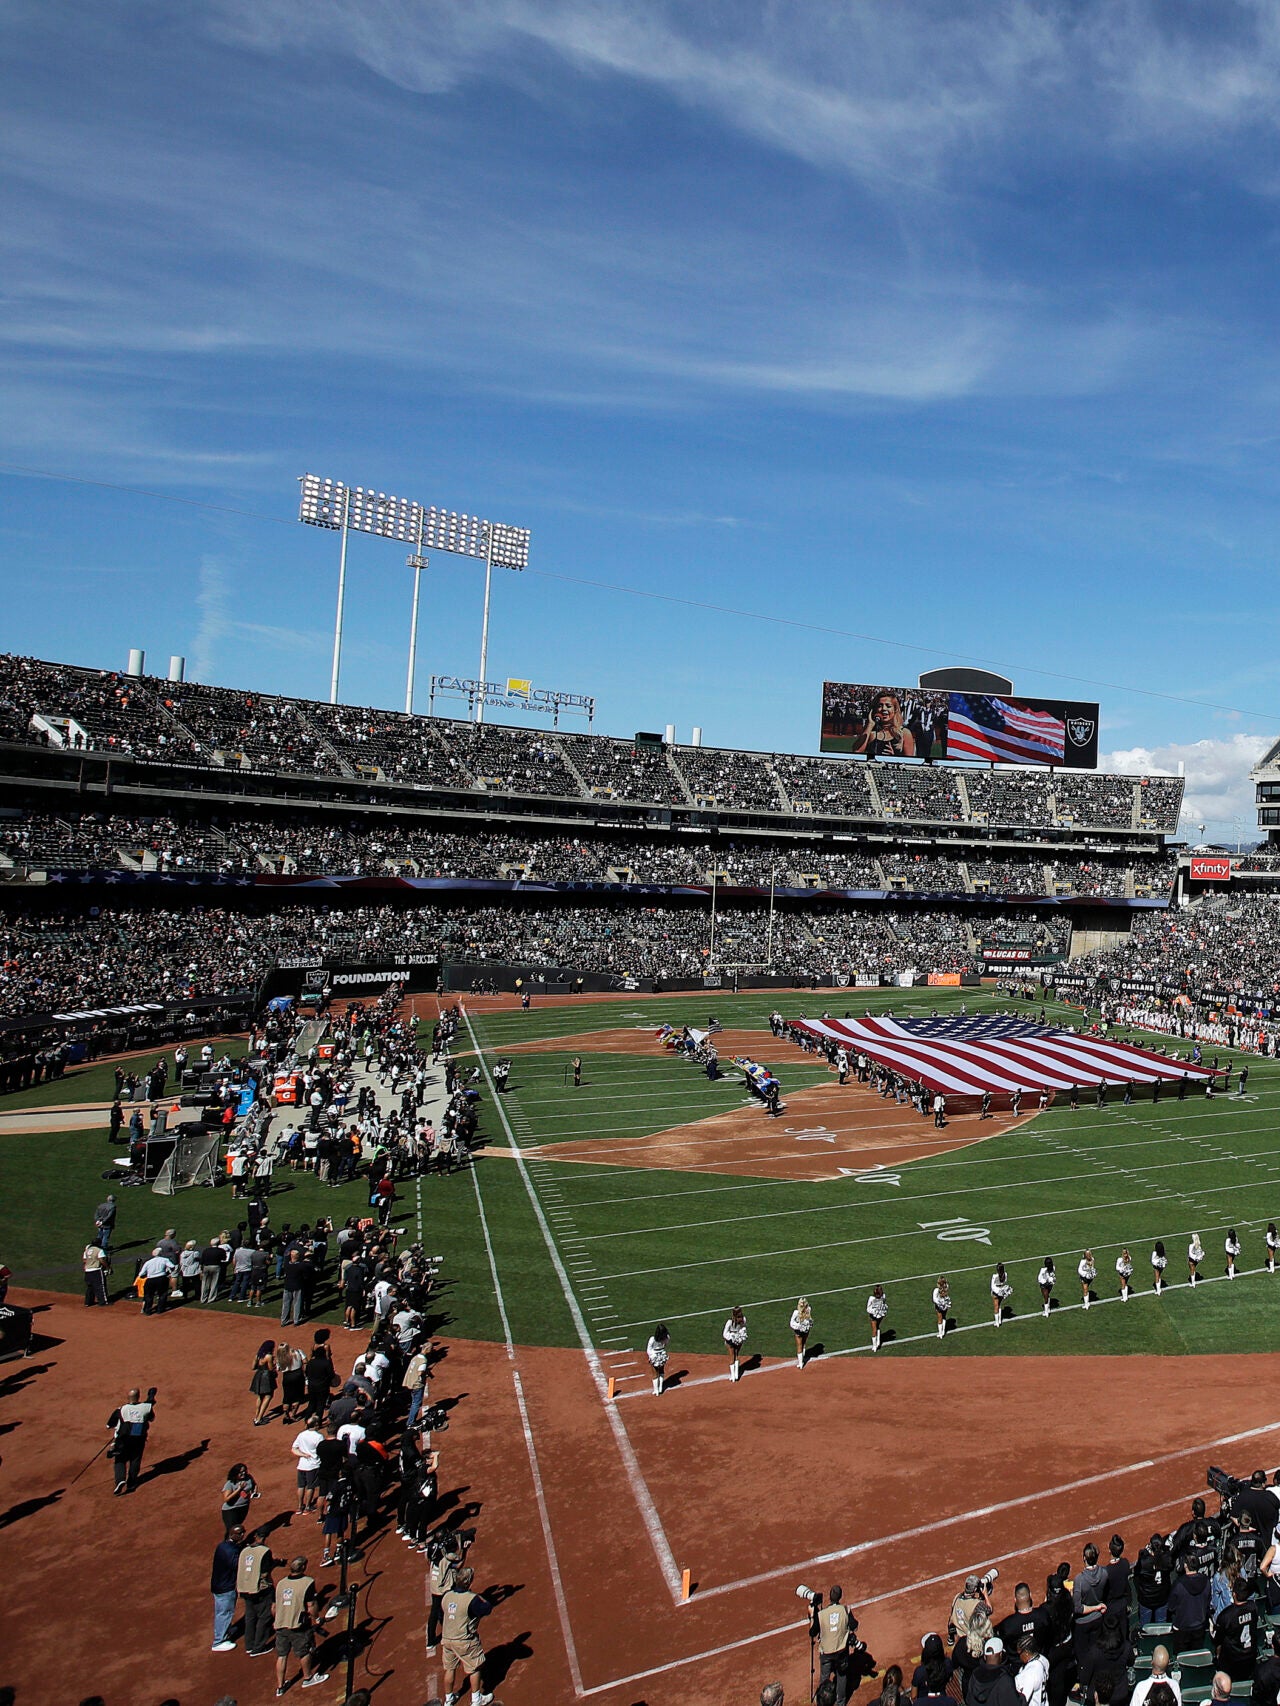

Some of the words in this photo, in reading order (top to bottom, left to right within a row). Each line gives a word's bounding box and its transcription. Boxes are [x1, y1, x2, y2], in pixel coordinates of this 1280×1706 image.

[1193, 862, 1229, 876] xfinity
[395, 955, 404, 964] THE
[408, 954, 438, 965] DARKSIDE
[992, 950, 1016, 958] LUCAS
[1017, 950, 1030, 958] OIL
[333, 971, 410, 985] FOUNDATION
[1121, 982, 1154, 991] OAKLAND
[1201, 993, 1228, 1002] OAKLAND
[837, 1164, 902, 1184] 20
[917, 1217, 990, 1241] 10
[1155, 1571, 1162, 1584] 4
[1238, 1613, 1252, 1624] CARR
[1022, 1622, 1035, 1632] CARR
[1240, 1624, 1251, 1648] 4
